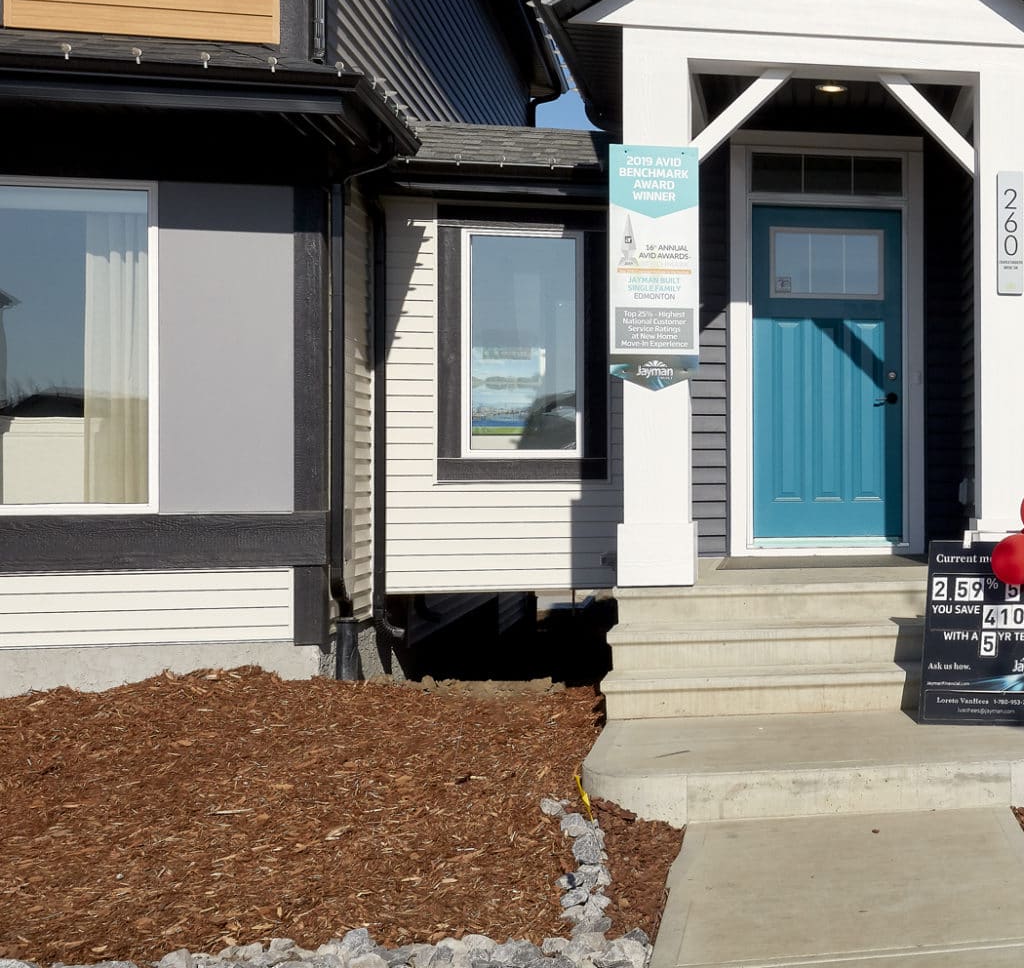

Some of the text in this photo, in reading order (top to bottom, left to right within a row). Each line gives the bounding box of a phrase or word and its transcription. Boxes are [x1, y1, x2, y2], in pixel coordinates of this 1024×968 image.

[626, 155, 682, 167] 2019 AVID
[618, 167, 689, 179] BENCHMARK
[633, 179, 675, 190] AWARD
[632, 191, 676, 201] WINNER
[1003, 188, 1018, 256] 260
[658, 245, 689, 253] ANNUAL
[638, 251, 657, 260] AVID
[627, 275, 681, 284] JAYMAN BUILT
[633, 292, 676, 300] EDMONTON
[636, 364, 674, 378] Jayman
[936, 553, 977, 564] Current
[935, 580, 983, 602] 2.59
[931, 605, 953, 614] YOU
[954, 605, 981, 614] SAVE
[943, 631, 969, 641] WITH
[970, 632, 979, 641] A
[983, 636, 995, 653] 5
[998, 632, 1011, 641] YR
[928, 662, 943, 670] Ask
